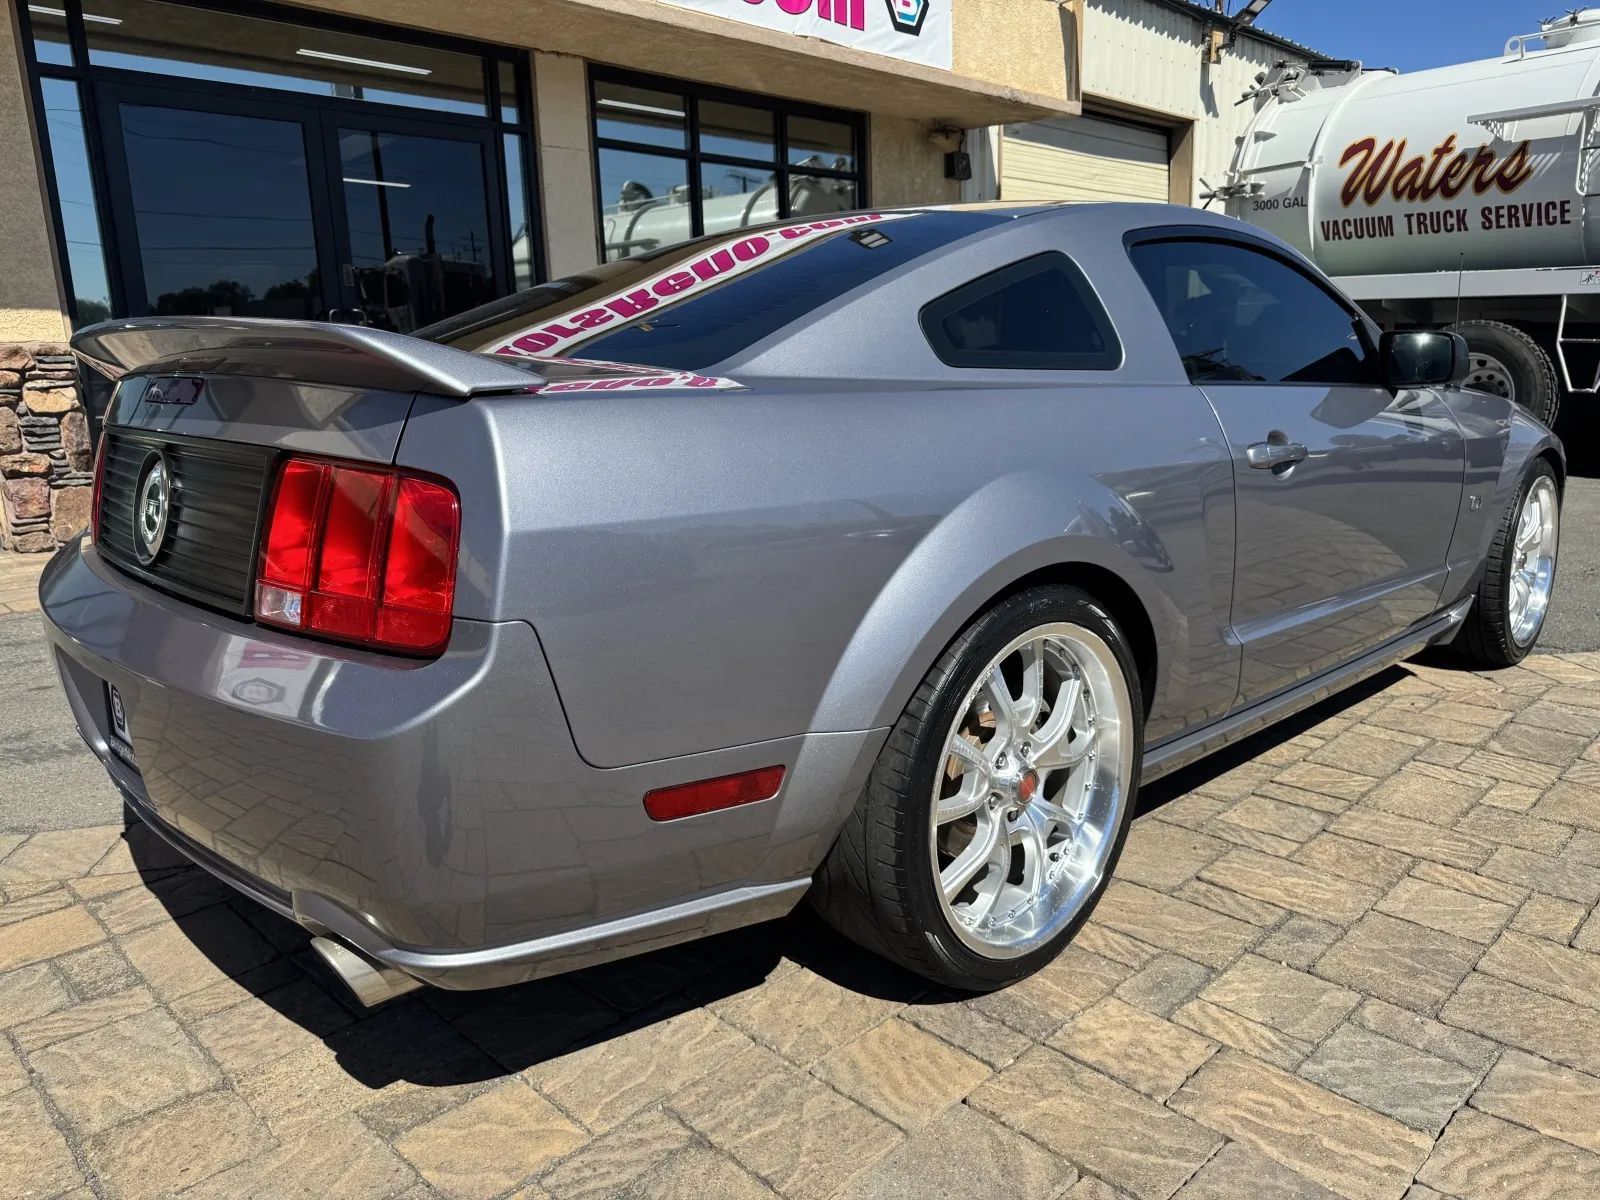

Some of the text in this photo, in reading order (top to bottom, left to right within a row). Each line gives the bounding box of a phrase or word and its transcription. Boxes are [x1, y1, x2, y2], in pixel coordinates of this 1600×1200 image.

[1338, 132, 1536, 209] Waters
[1252, 196, 1308, 211] 3000 GAL
[1320, 200, 1572, 242] VACUUM TRUCK SERVICE
